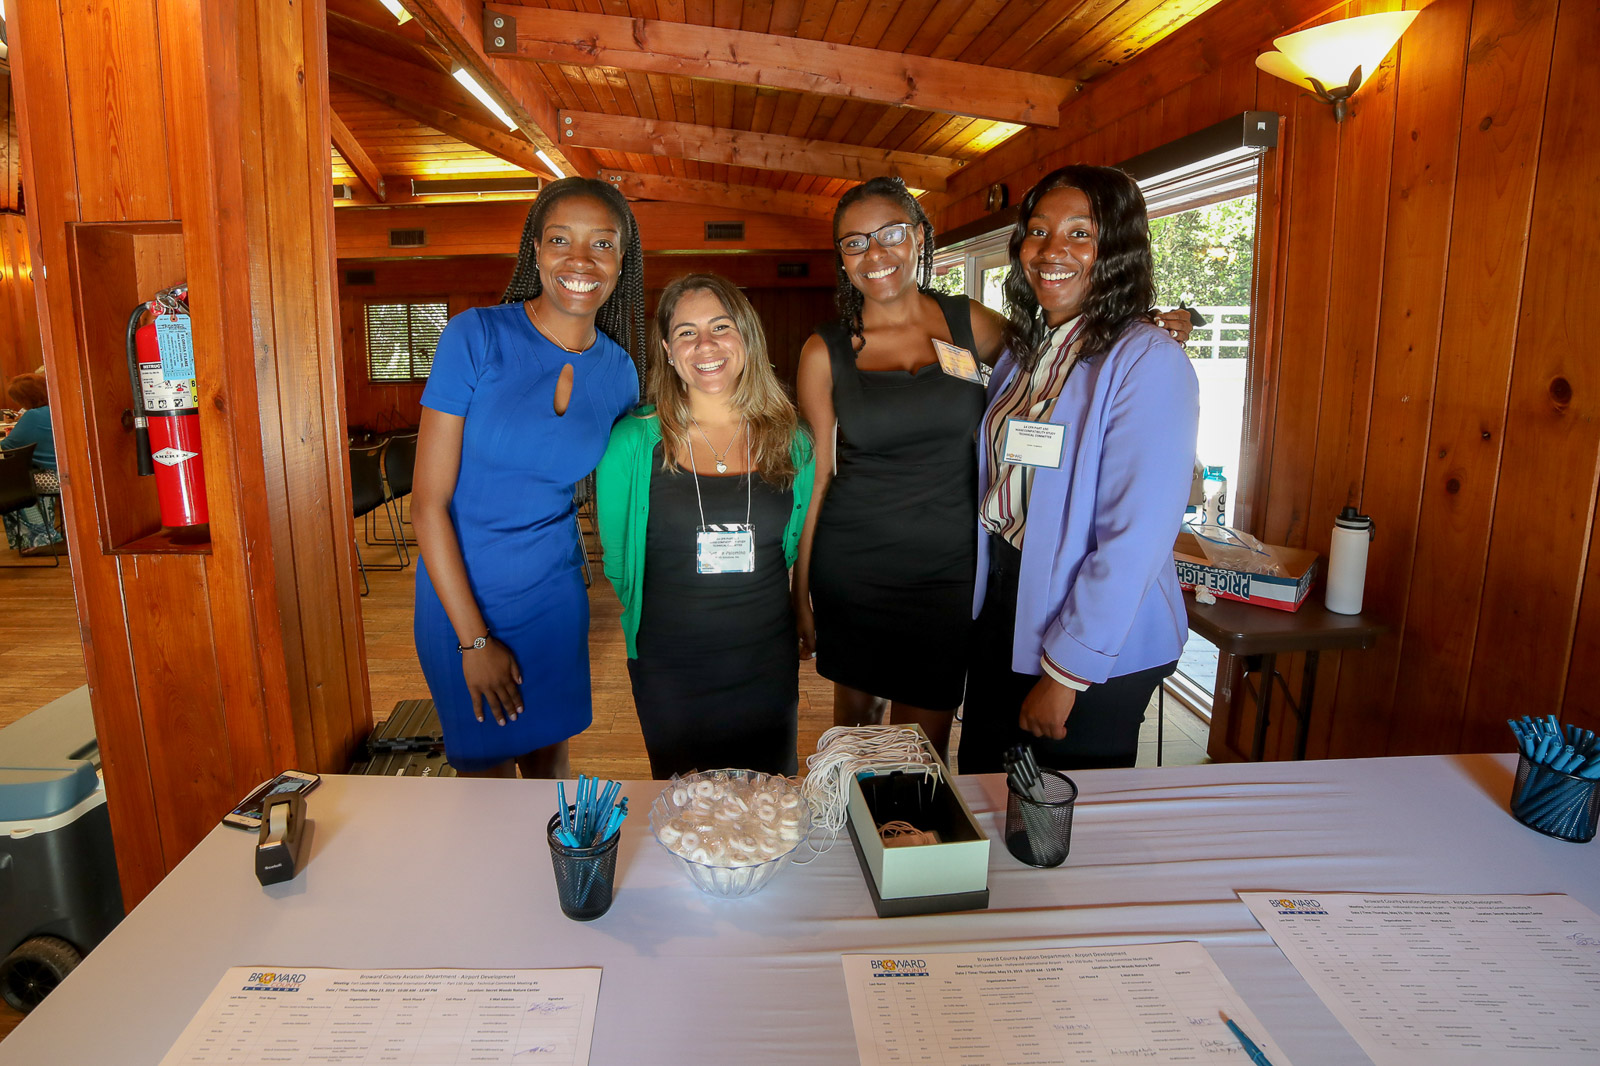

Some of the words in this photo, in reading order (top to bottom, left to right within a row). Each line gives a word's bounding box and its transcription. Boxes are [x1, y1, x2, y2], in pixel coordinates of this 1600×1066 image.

[1203, 567, 1237, 576] COPY
[1210, 573, 1252, 600] PRICE
[1269, 899, 1321, 908] BROWARD
[871, 960, 926, 969] BROWARD
[248, 973, 306, 984] BROWARD
